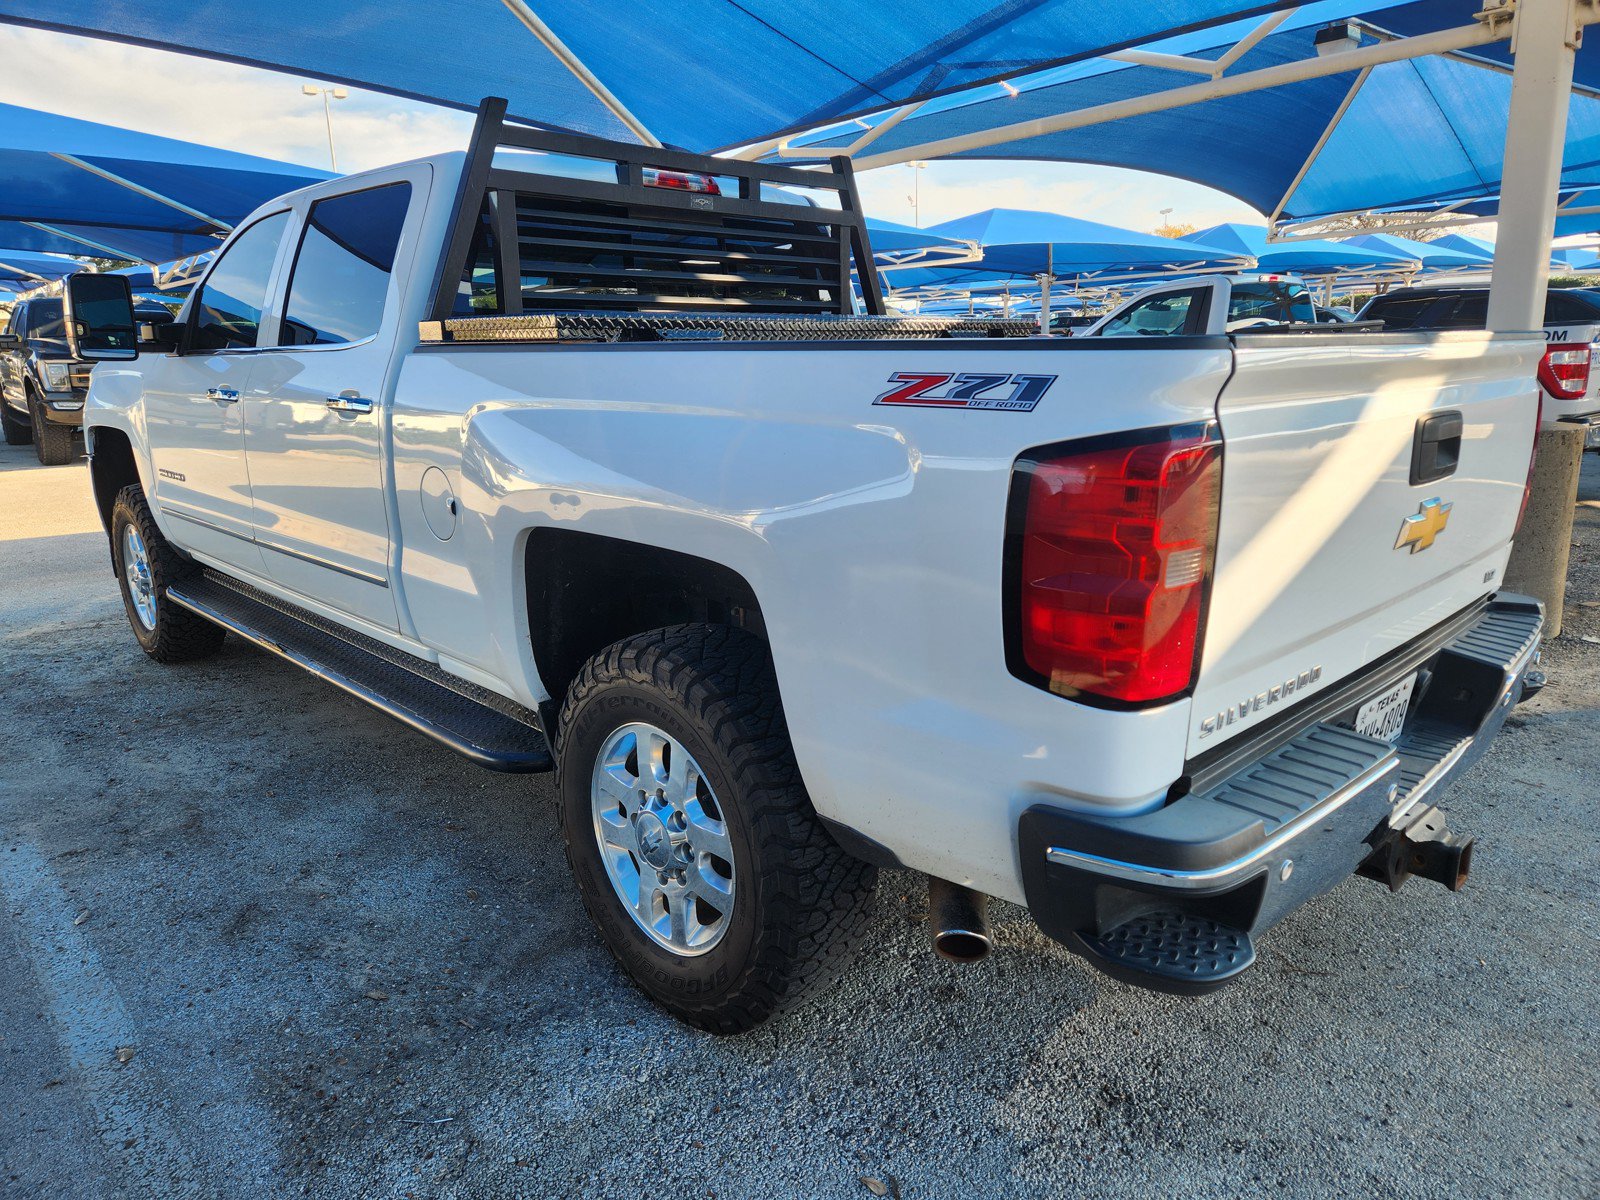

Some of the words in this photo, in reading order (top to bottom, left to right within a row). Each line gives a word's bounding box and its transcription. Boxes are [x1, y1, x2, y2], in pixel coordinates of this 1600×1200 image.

[871, 371, 1059, 412] Z71
[968, 400, 996, 408] OFF
[997, 401, 1032, 409] ROAD
[1199, 664, 1323, 739] SILVERADO
[1376, 689, 1400, 713] TEXAS
